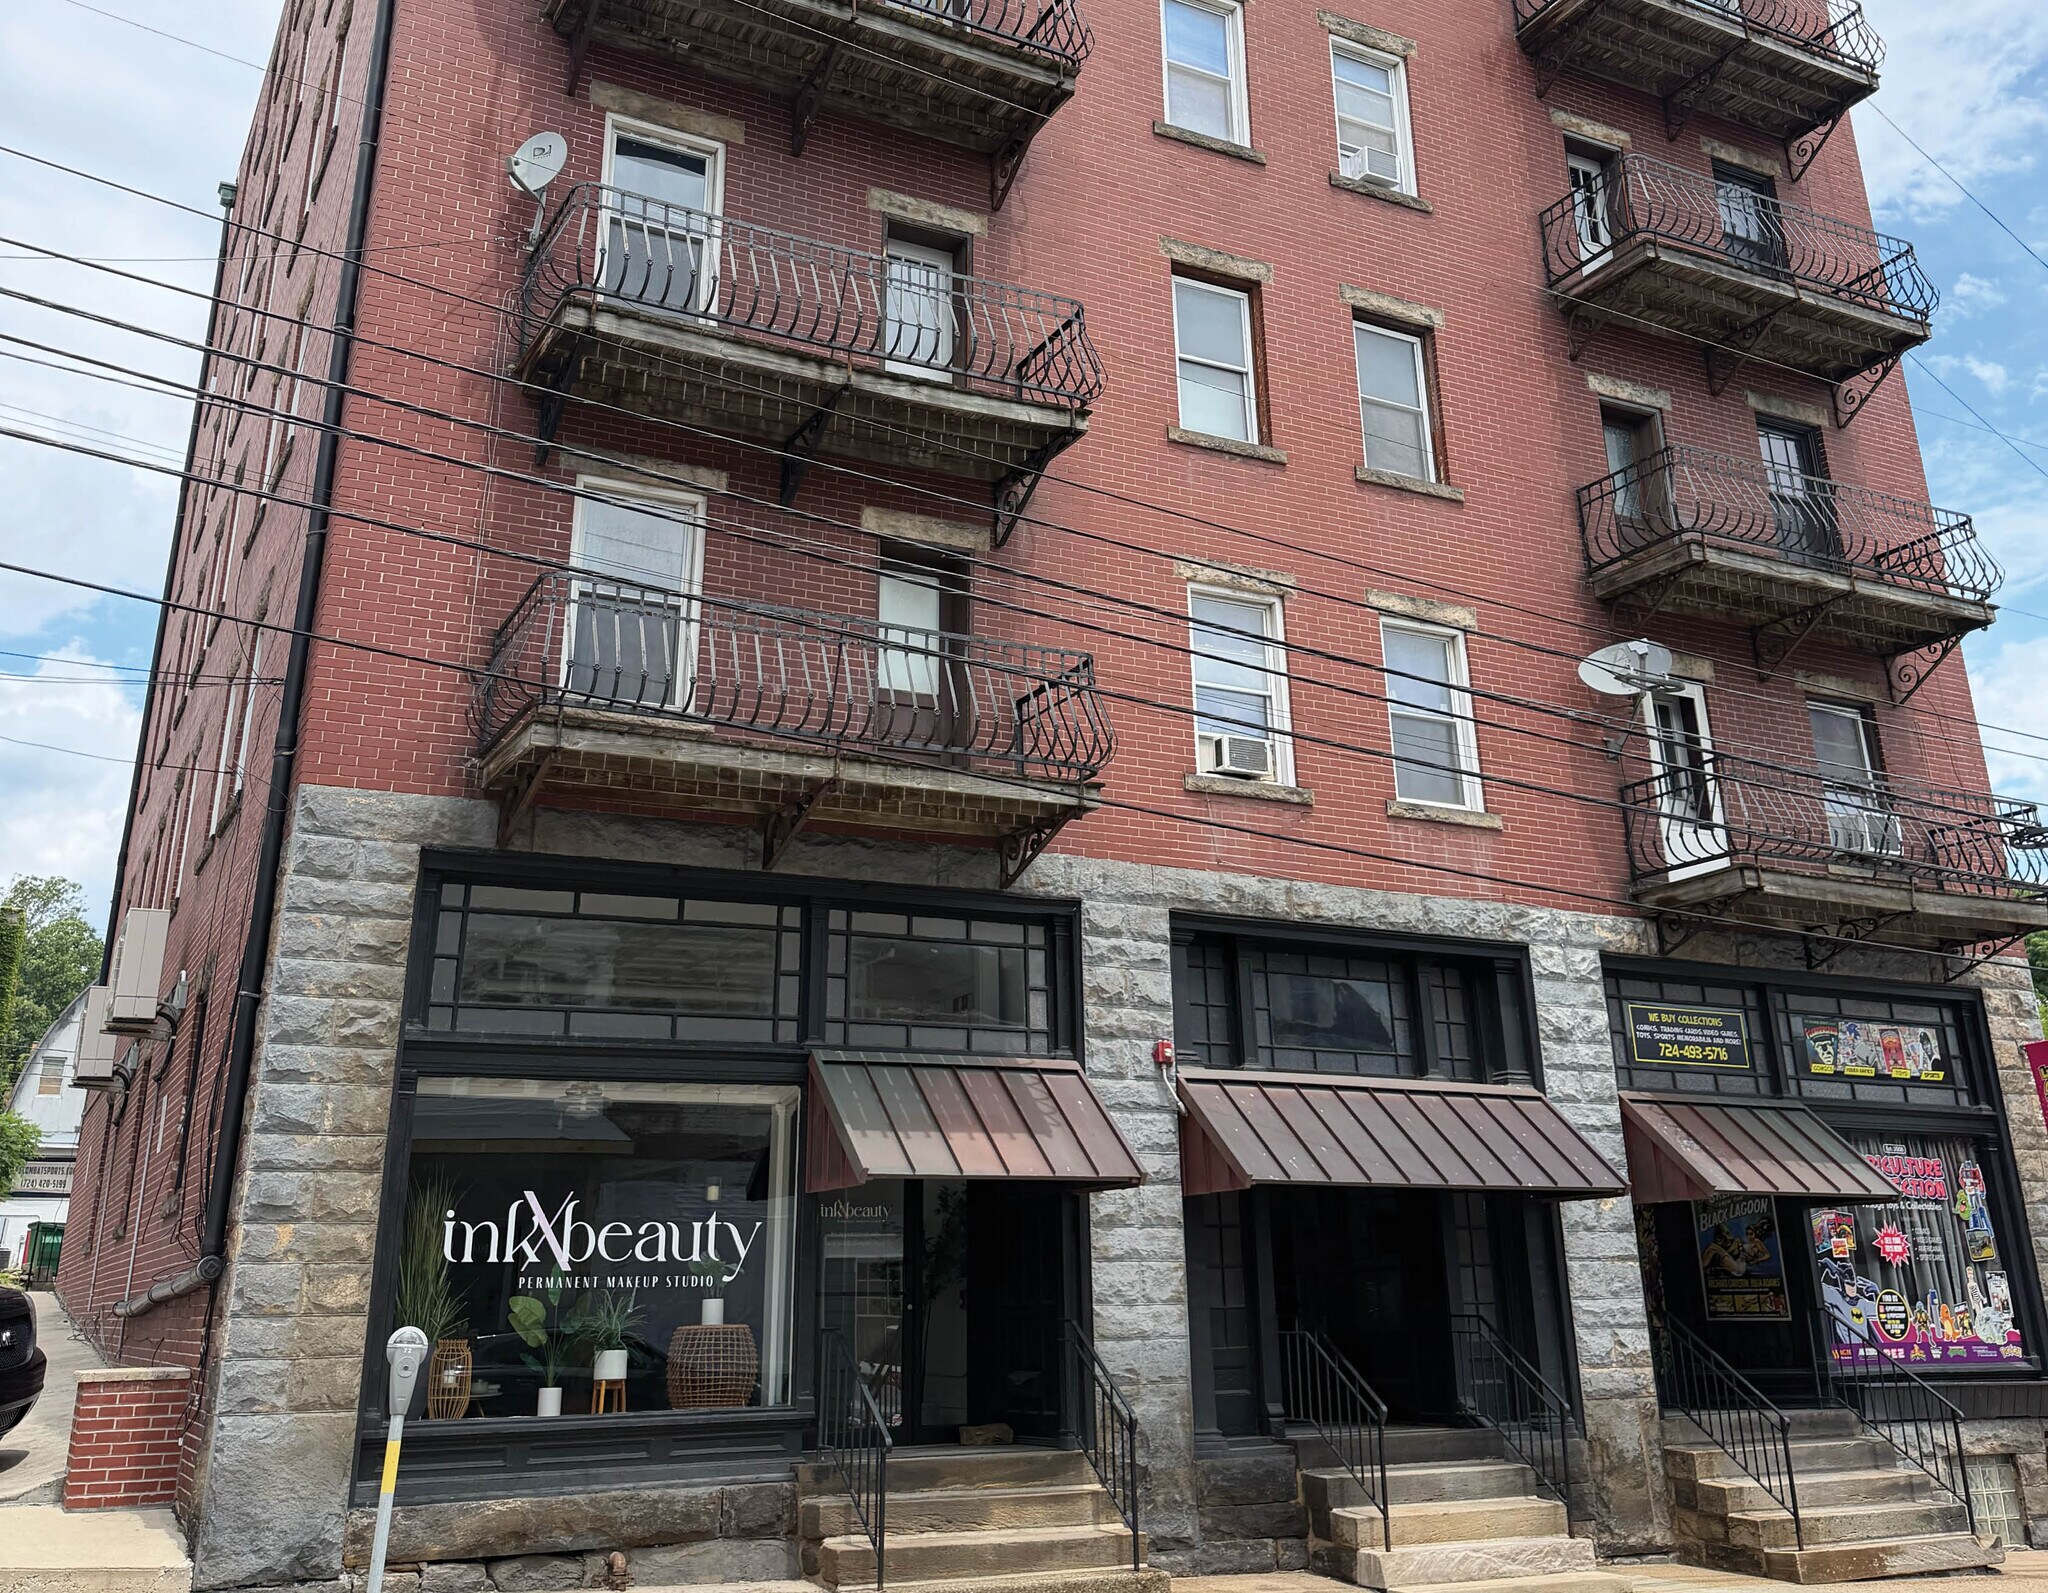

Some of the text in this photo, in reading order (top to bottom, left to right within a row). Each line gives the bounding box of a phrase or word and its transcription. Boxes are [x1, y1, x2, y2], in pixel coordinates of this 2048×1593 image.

[1648, 1013, 1723, 1026] WE BUY COLLECTIONS
[1653, 1033, 1676, 1041] SPORTS
[1659, 1043, 1729, 1060] 724-493-5716
[1700, 1208, 1729, 1232] BLACK
[1730, 1198, 1768, 1218] LAGOON
[519, 1275, 714, 1289] PERMANENT MAKEUP STUDIO
